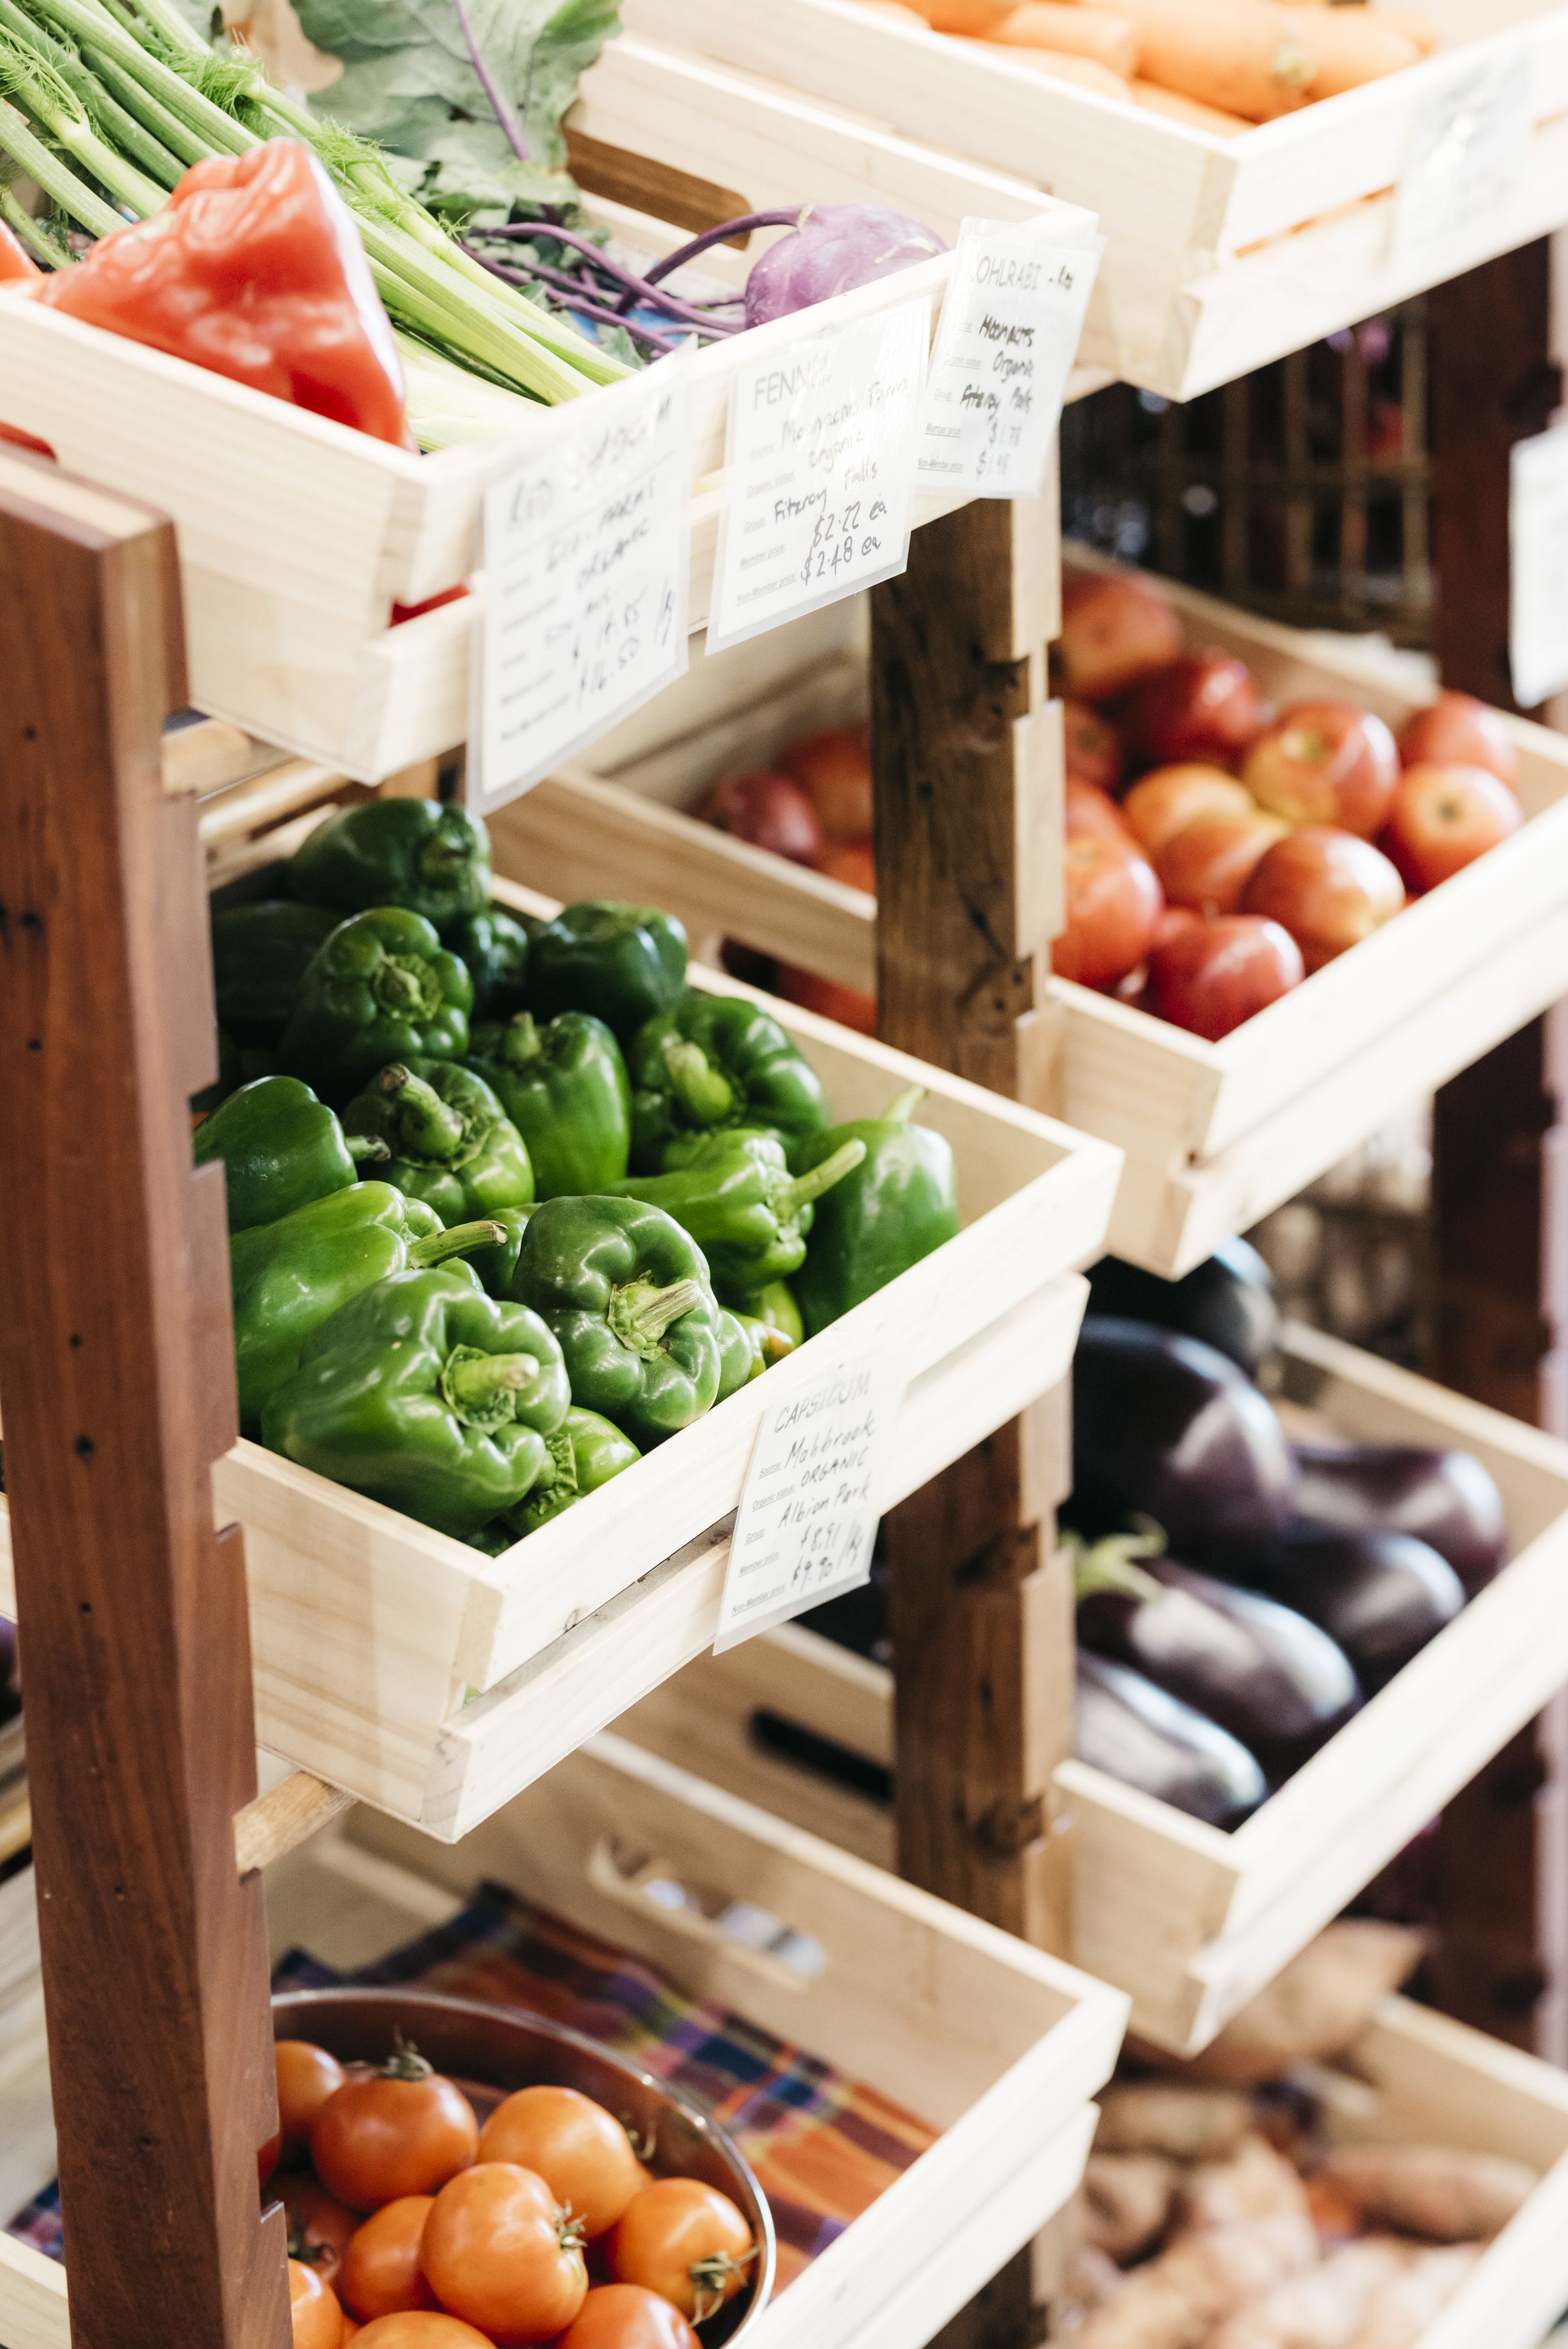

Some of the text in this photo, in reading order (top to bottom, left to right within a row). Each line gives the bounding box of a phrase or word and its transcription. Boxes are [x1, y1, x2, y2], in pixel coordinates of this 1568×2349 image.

[971, 255, 1042, 291] OHLRABI
[926, 423, 948, 436] Member
[775, 487, 827, 525] Fitzroy
[737, 536, 882, 606] Non-Member price: $2.48 ea
[741, 549, 766, 570] Member
[767, 542, 786, 559] price:
[774, 1370, 871, 1434] CAPSICUM
[752, 1447, 869, 1512] Organic status: ORGANIC
[758, 1461, 782, 1479] Source:
[745, 1470, 871, 1546] Group: Albion Park
[739, 1558, 763, 1578] Member
[731, 1595, 769, 1617] Non-Member
